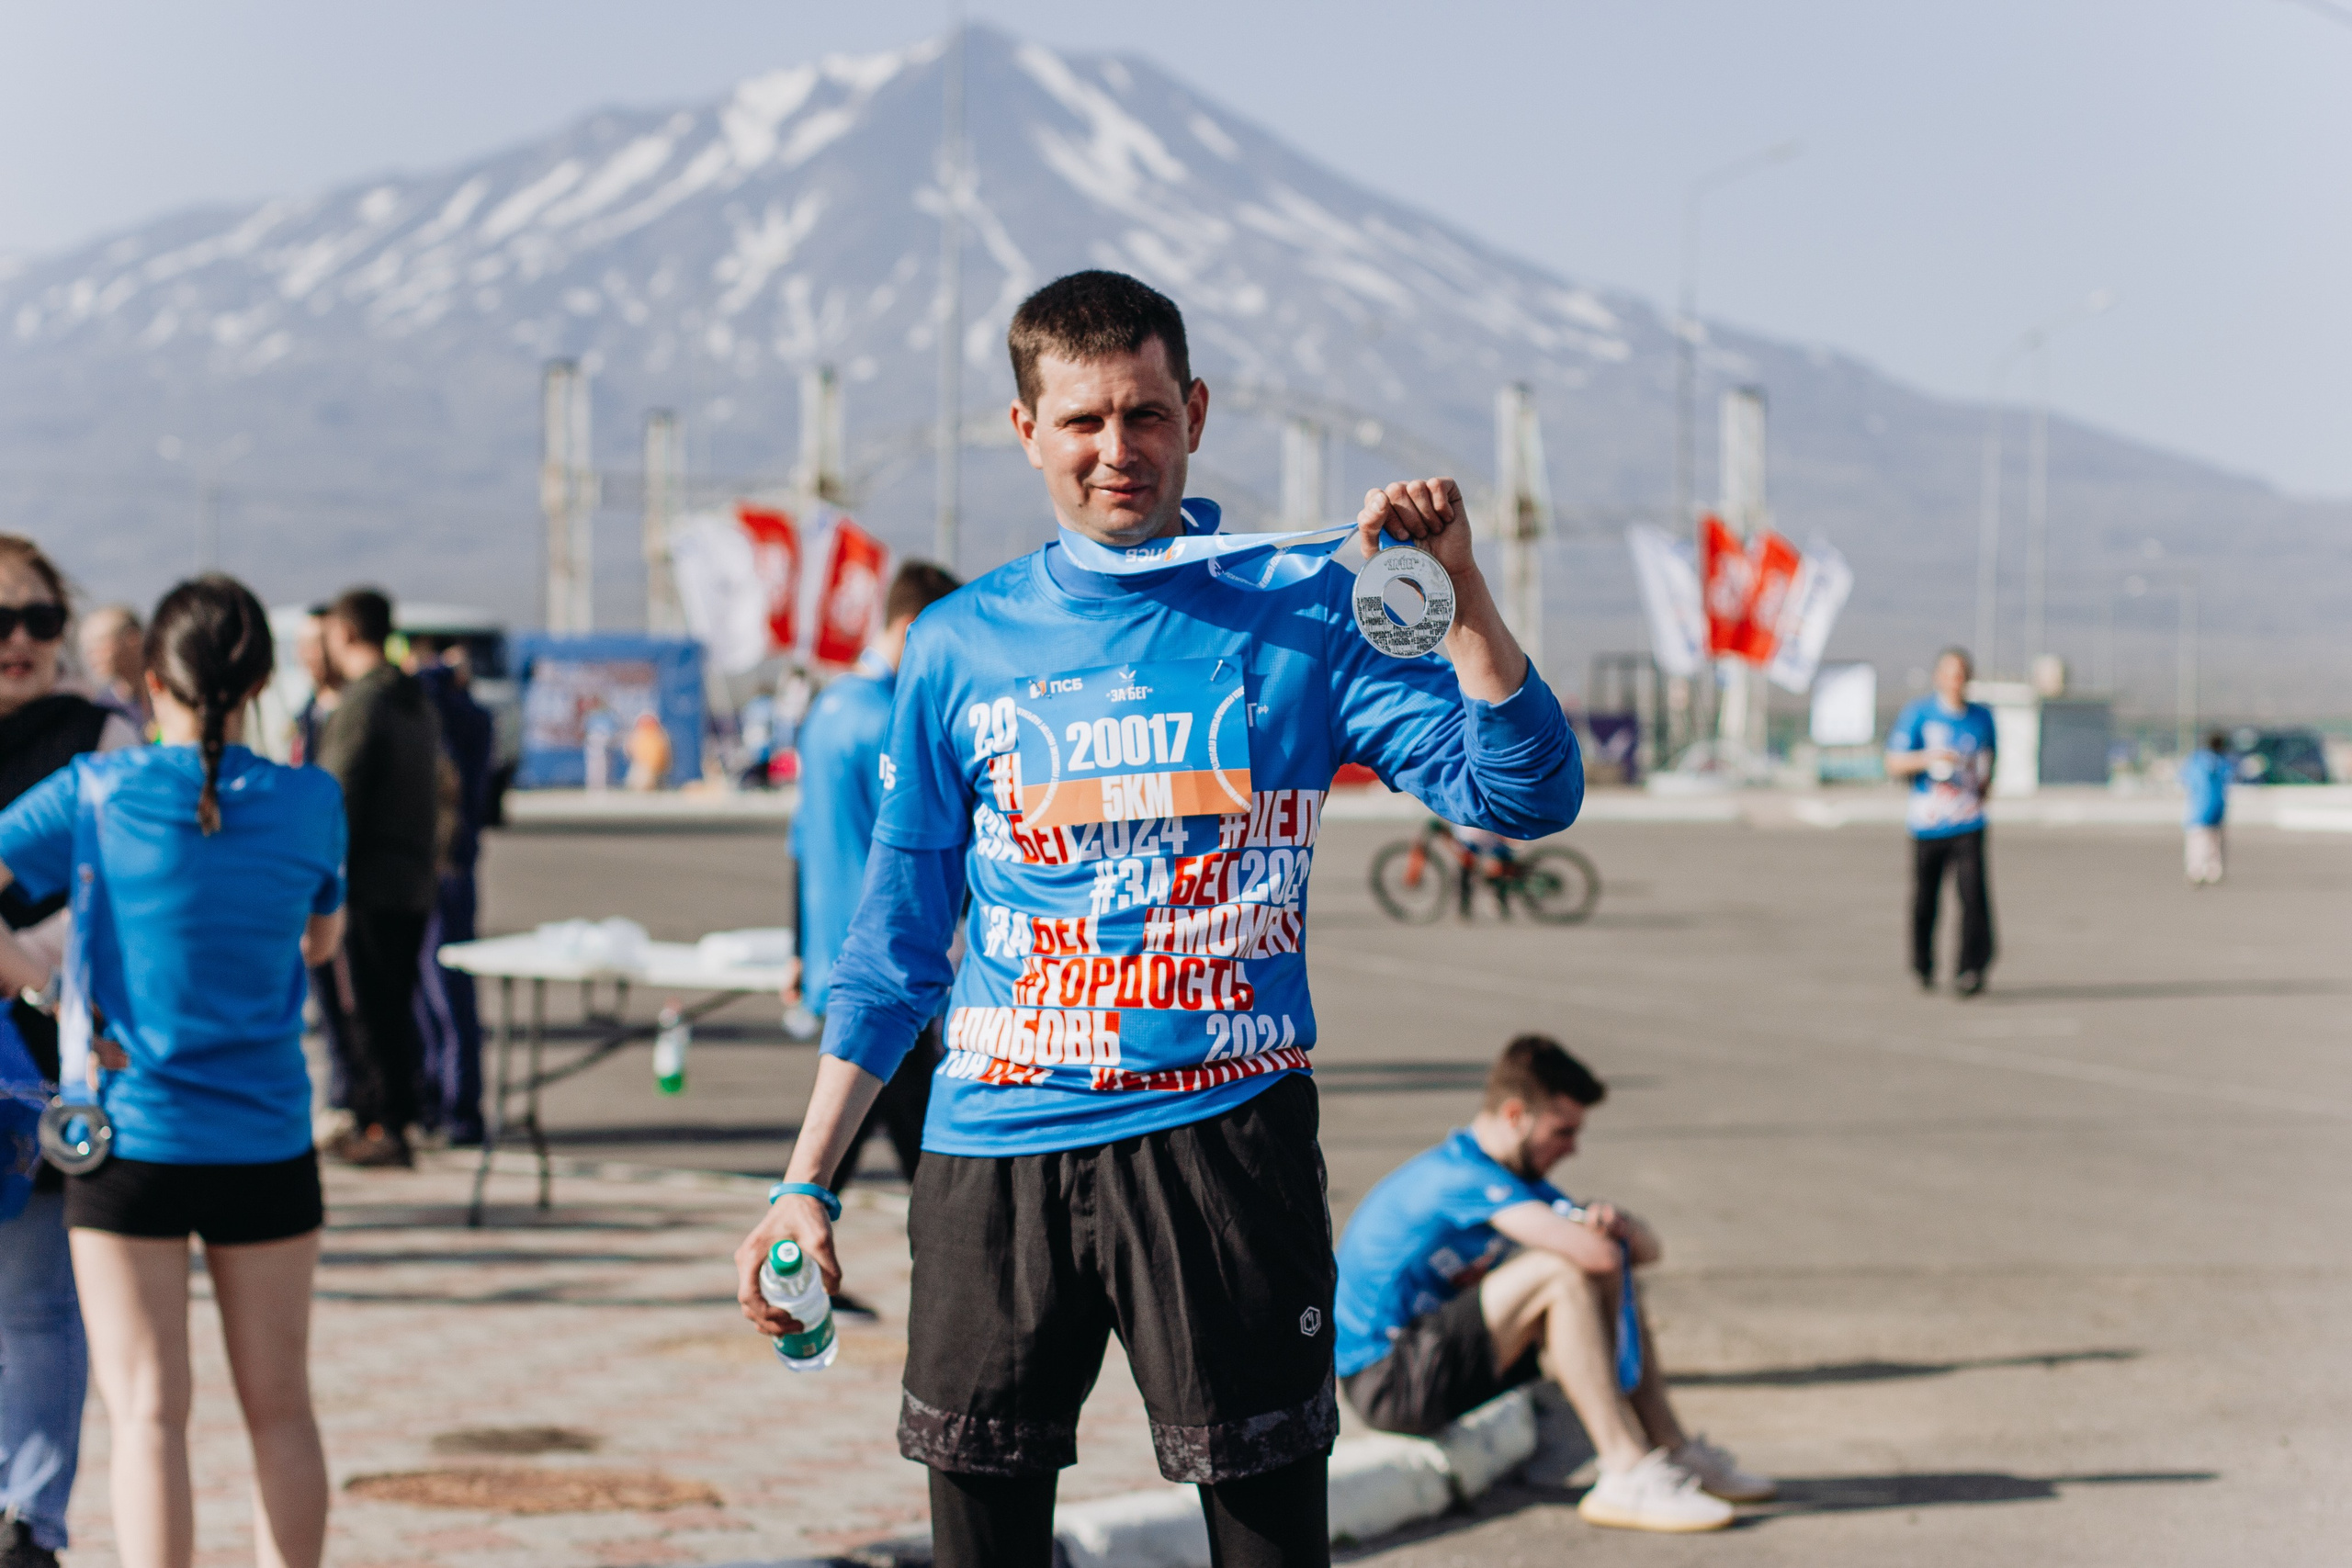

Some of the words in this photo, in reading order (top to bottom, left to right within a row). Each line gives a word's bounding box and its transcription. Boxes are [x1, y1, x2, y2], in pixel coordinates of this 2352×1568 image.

[1050, 677, 1083, 694] ПСБ
[1065, 712, 1193, 772] 20017
[1012, 953, 1255, 1012] #ГОРДОСТЬ
[948, 1007, 1122, 1066] #ЛЮБОВЬ
